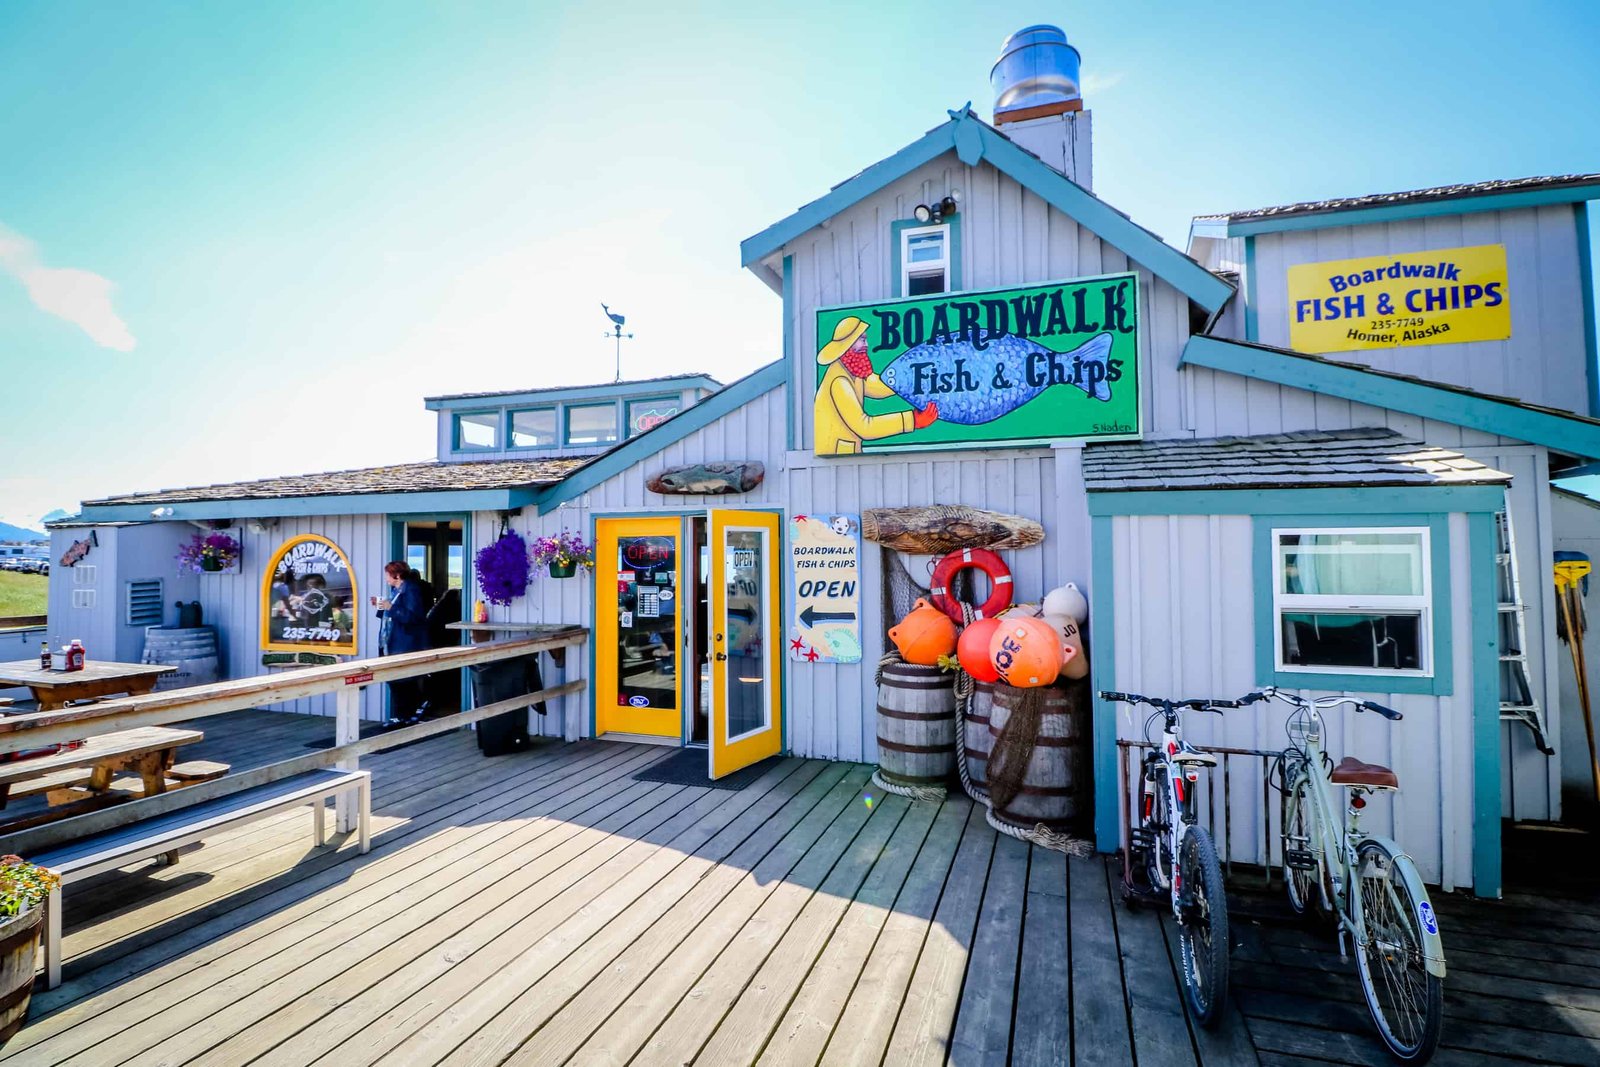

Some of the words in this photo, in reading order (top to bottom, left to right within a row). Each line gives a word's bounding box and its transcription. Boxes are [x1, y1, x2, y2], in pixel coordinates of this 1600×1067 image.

[1328, 261, 1462, 293] Boardwalk
[1296, 294, 1365, 323] FISH
[1376, 292, 1395, 315] &
[1405, 282, 1503, 312] CHIPS
[872, 282, 1134, 352] BOARDWALK
[1370, 317, 1424, 330] 235-7749
[1346, 328, 1398, 343] Homer,
[1402, 321, 1451, 341] Alaska
[909, 358, 979, 396] Fish
[991, 361, 1012, 390] &
[1024, 352, 1123, 398] Chips
[278, 543, 347, 573] BOARDWALK
[627, 545, 668, 560] OPEN
[734, 551, 753, 567] OPEN
[794, 547, 854, 555] BOARDWALK
[797, 560, 817, 569] FISH
[819, 560, 825, 568] &
[828, 560, 855, 568] CHIPS
[799, 580, 856, 598] OPEN
[282, 627, 341, 641] 235-7749
